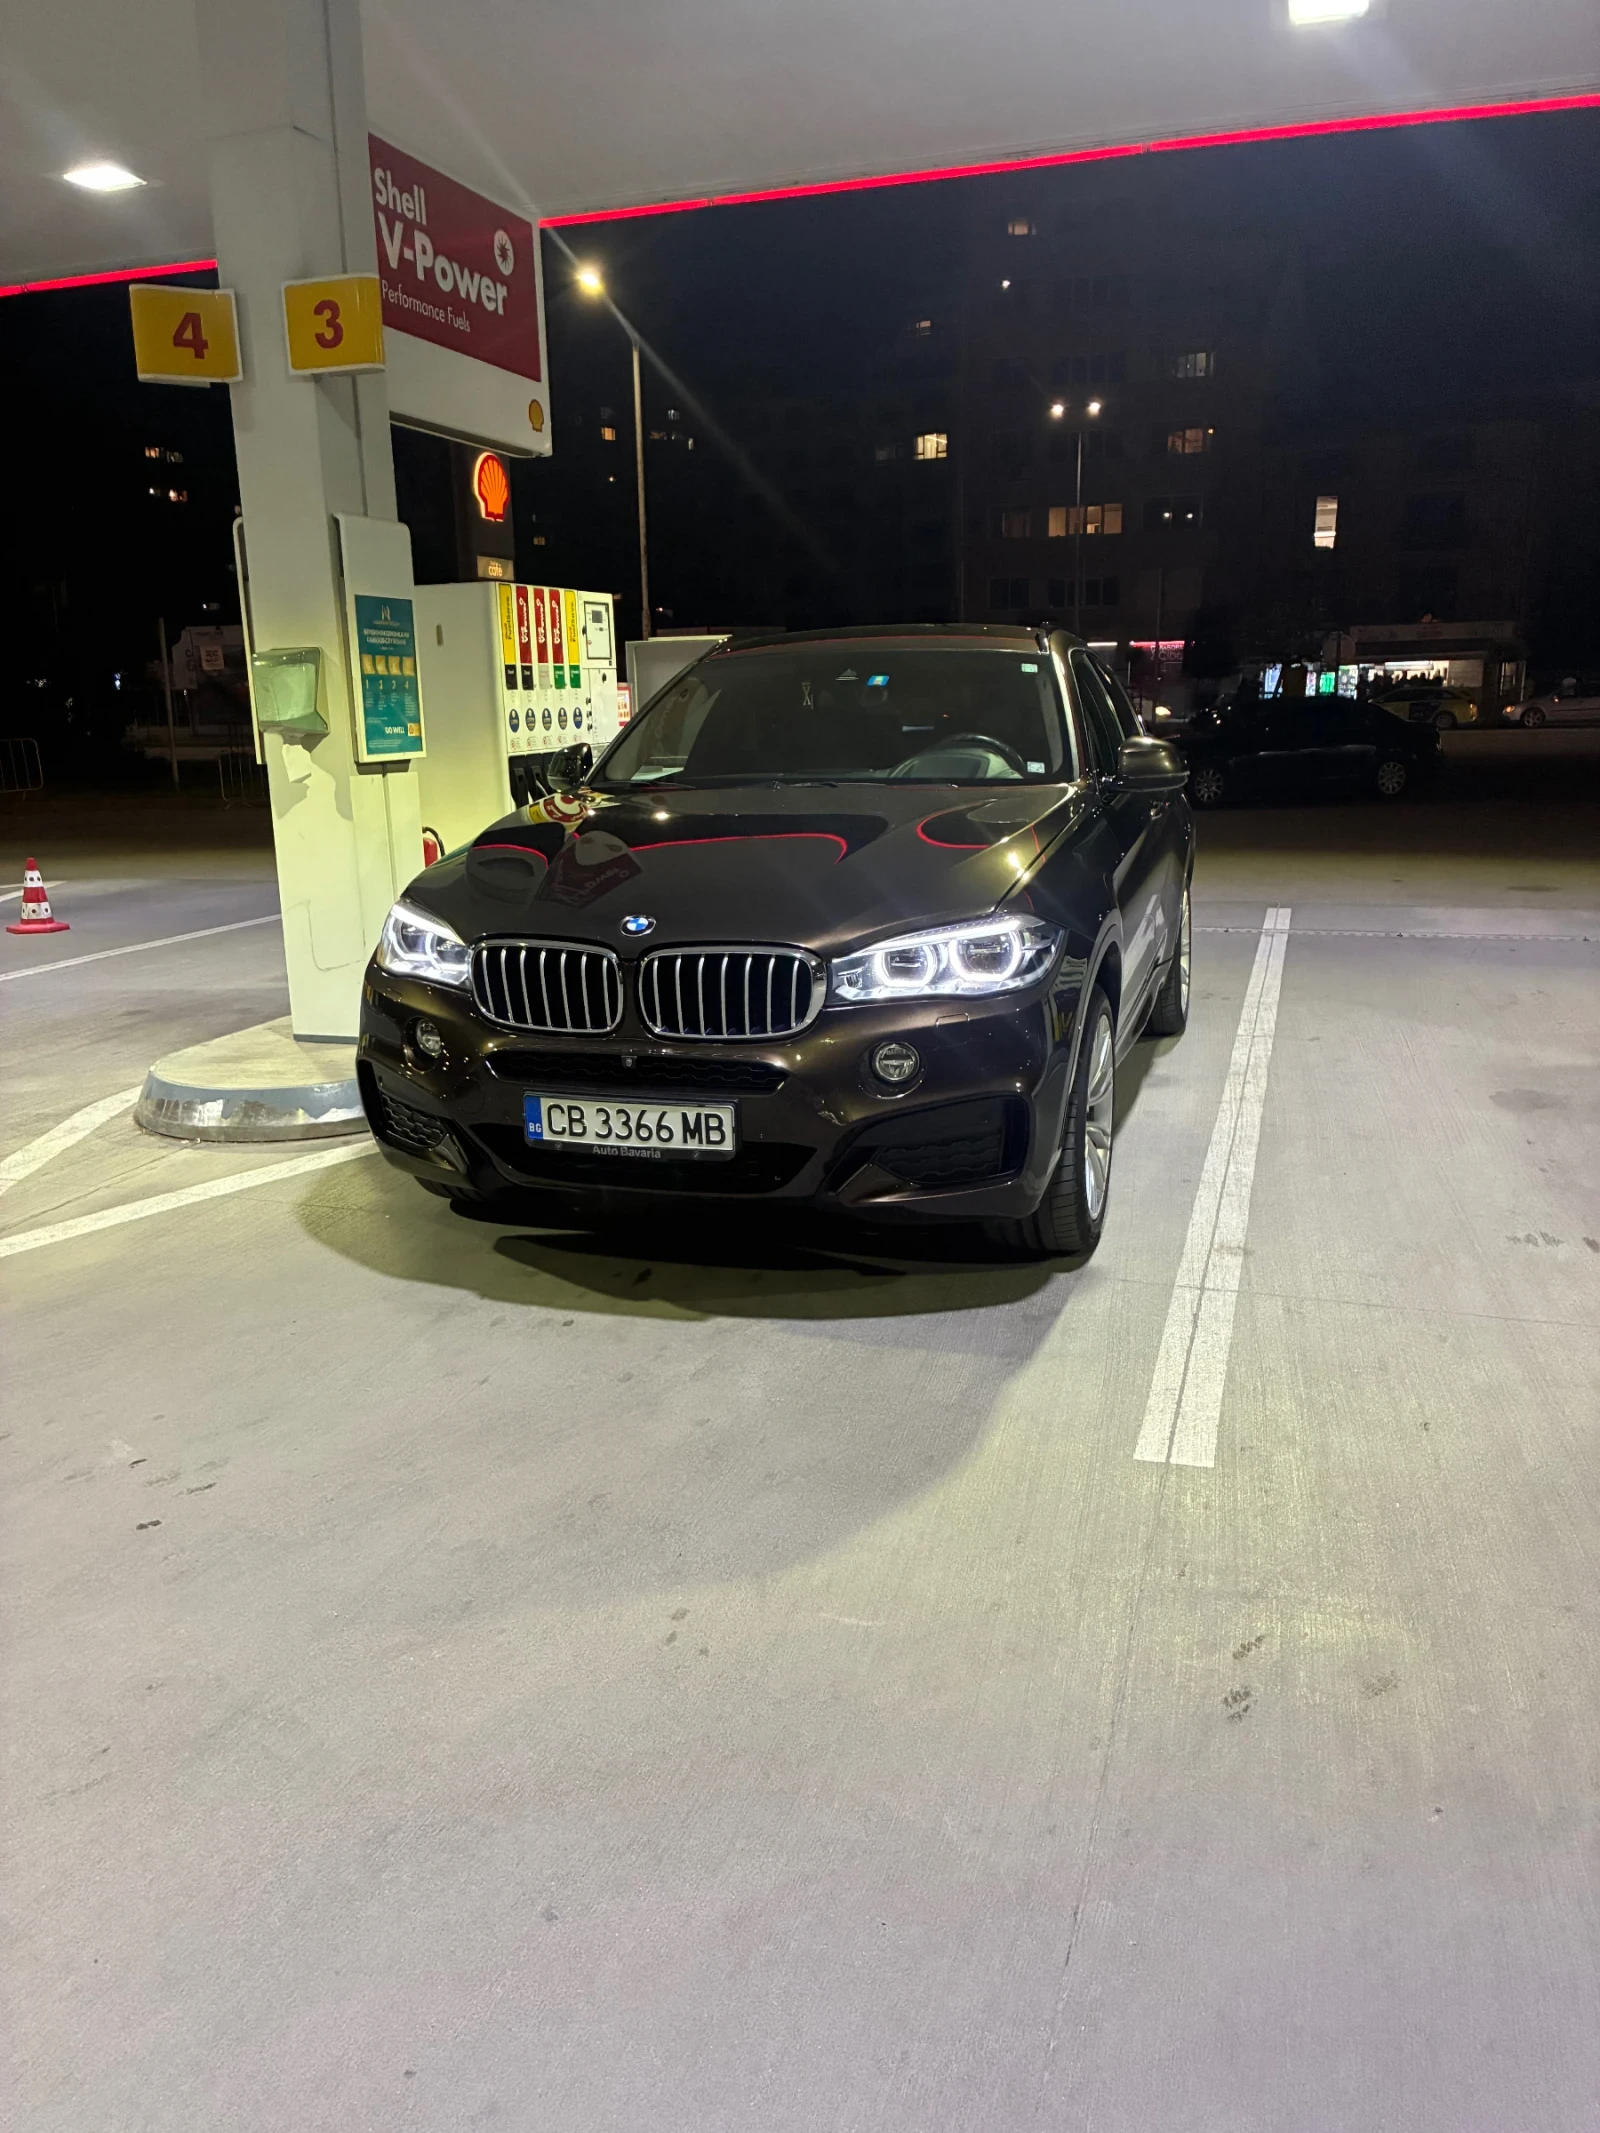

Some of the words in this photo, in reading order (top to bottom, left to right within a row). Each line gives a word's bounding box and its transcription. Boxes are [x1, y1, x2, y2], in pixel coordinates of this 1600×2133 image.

[374, 167, 427, 226] Shell
[377, 211, 508, 316] V-Power
[313, 298, 345, 349] 3
[381, 279, 445, 324] Performance
[447, 306, 471, 333] Fuels
[172, 311, 209, 360] 4
[528, 1122, 542, 1133] BG
[547, 1103, 588, 1138] CB
[594, 1107, 675, 1143] 3366
[681, 1111, 726, 1146] MB
[592, 1145, 619, 1156] Auto
[620, 1146, 661, 1159] Bavaria
